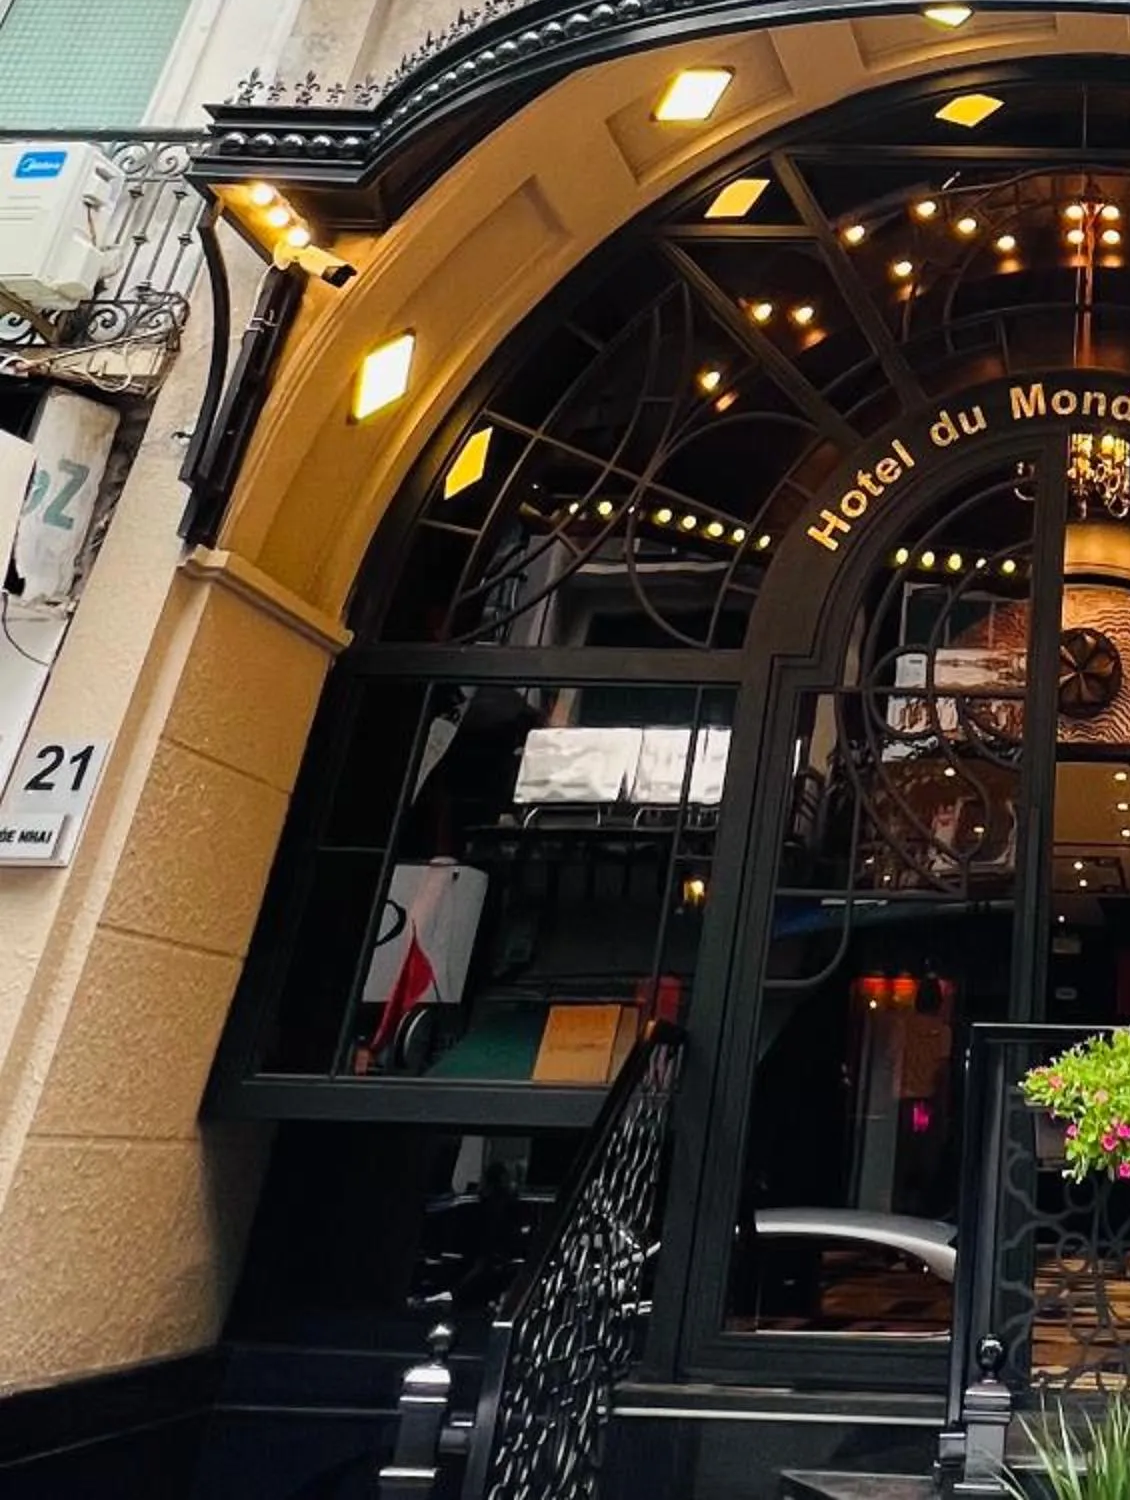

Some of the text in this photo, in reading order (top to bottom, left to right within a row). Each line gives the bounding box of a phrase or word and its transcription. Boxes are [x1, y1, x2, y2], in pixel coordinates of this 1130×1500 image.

[807, 438, 917, 552] Hotel
[929, 405, 987, 448] du
[24, 745, 95, 791] 21
